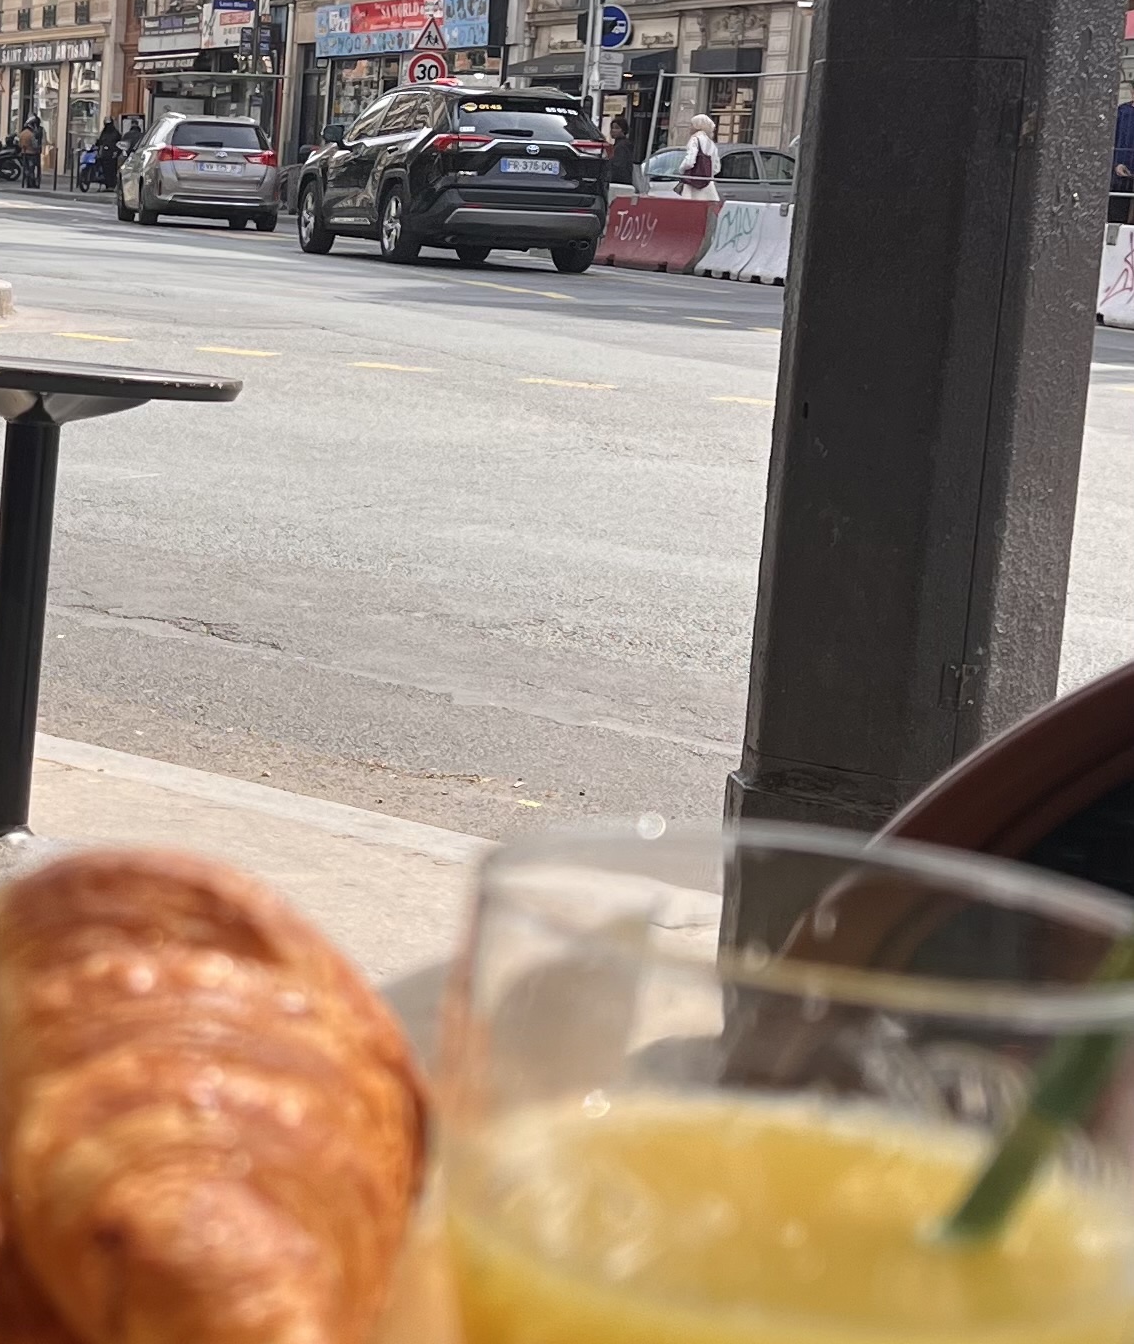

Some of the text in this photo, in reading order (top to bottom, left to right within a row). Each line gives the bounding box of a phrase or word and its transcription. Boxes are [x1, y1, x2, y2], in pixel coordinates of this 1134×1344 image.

[2, 48, 22, 64] SAINT
[23, 45, 53, 61] JOSEPH
[55, 41, 91, 60] ARTISAN
[415, 63, 439, 81] 30
